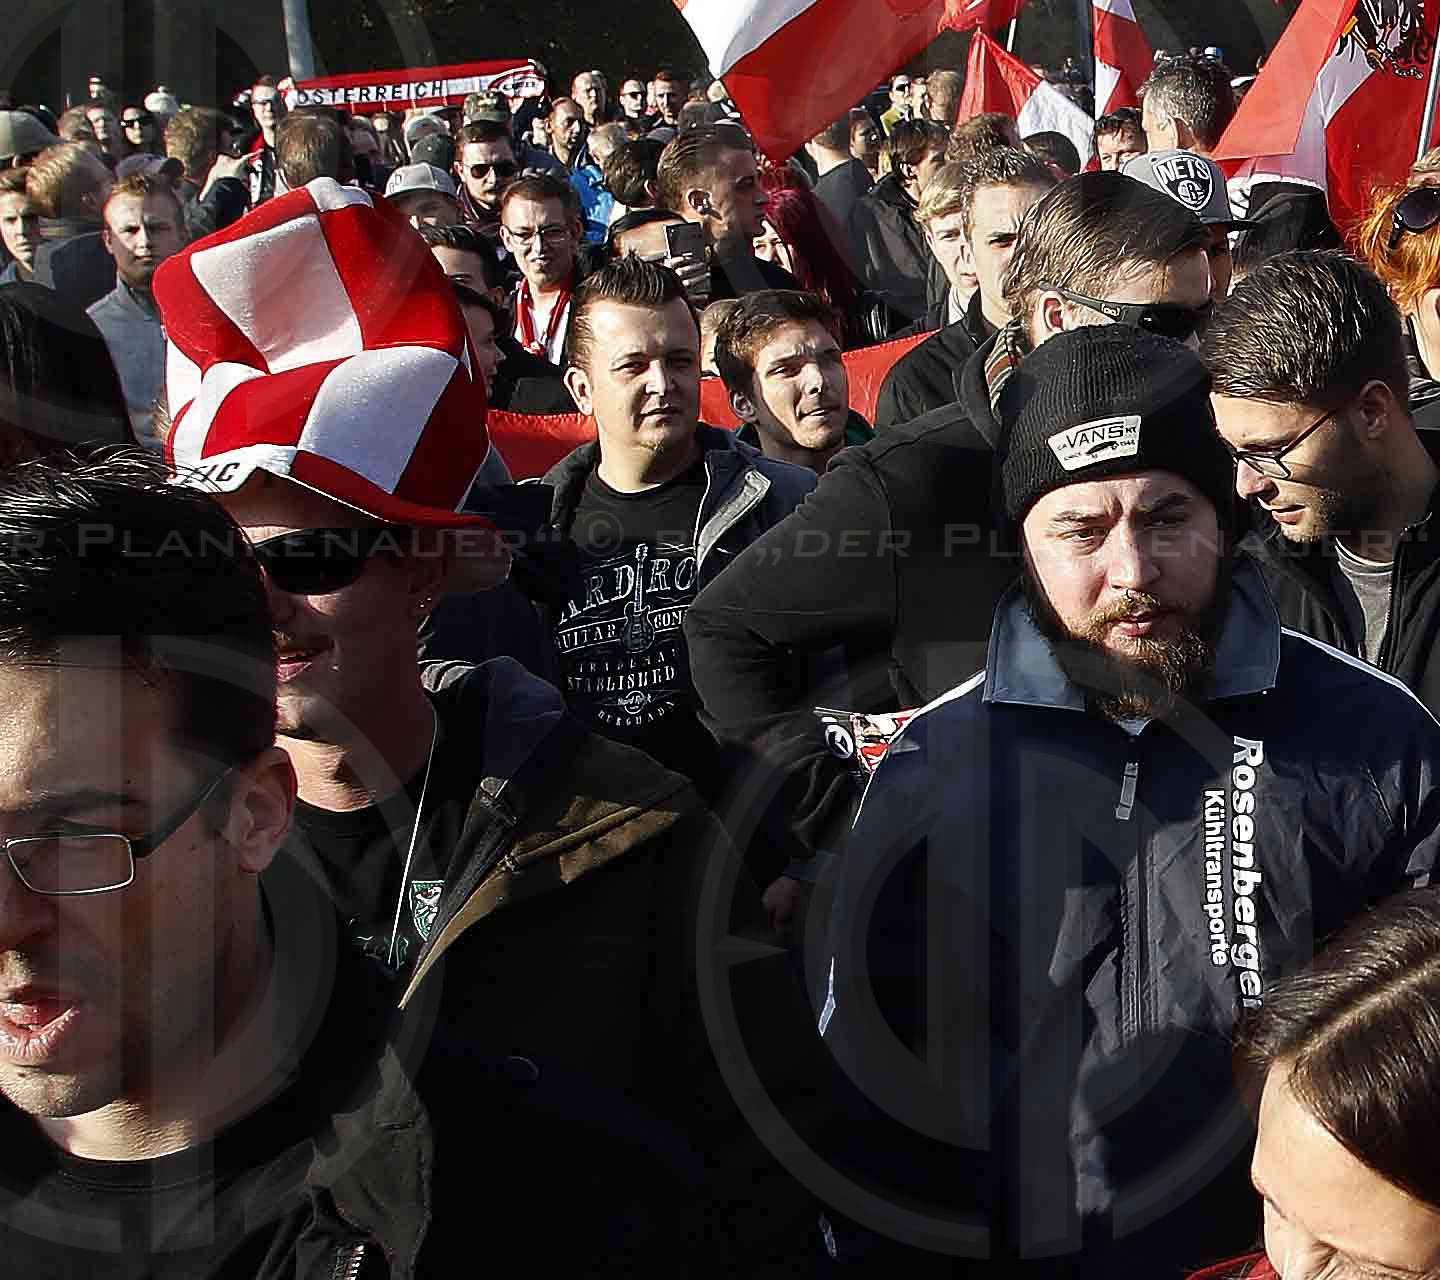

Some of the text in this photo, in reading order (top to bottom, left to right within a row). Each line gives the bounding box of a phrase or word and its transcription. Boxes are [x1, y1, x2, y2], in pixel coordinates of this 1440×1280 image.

[1157, 157, 1210, 185] NETS
[1065, 421, 1124, 448] VANS
[1202, 788, 1228, 967] Kühltransporte
